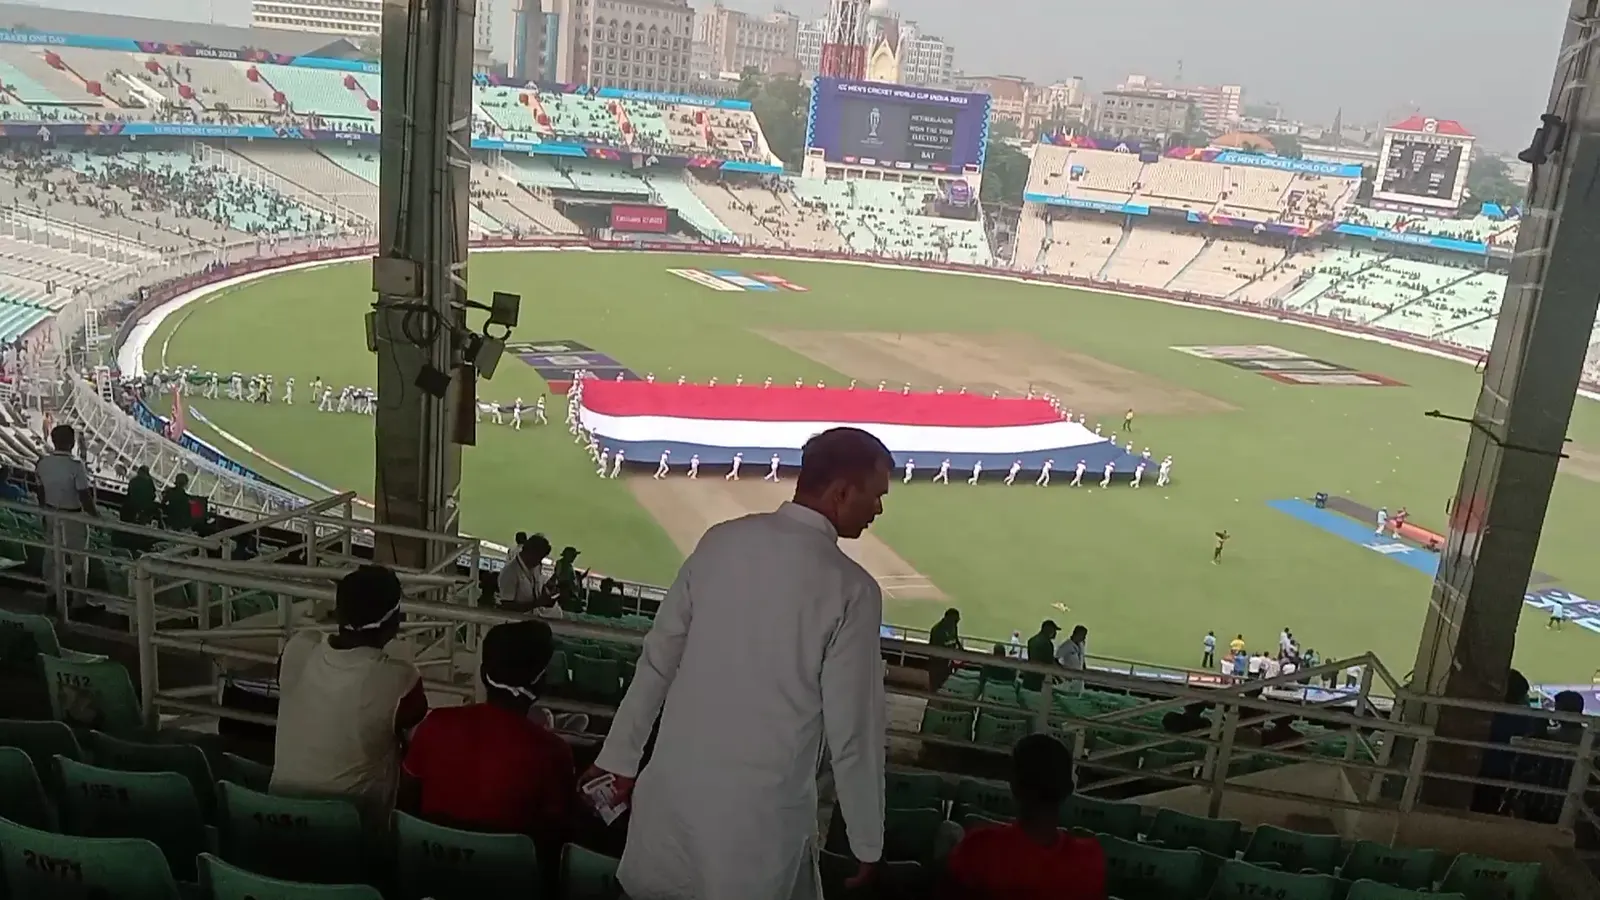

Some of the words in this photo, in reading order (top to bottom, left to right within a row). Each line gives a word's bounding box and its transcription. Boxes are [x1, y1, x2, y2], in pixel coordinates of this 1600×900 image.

[195, 48, 217, 57] INDIA
[867, 87, 892, 96] CRICKET
[893, 90, 916, 98] WORLD
[929, 94, 949, 102] INDIA
[949, 96, 968, 104] 2023
[921, 151, 936, 159] BAT
[1261, 158, 1291, 168] CRICKET
[1292, 162, 1319, 171] WORLD
[1320, 164, 1338, 172] CUP
